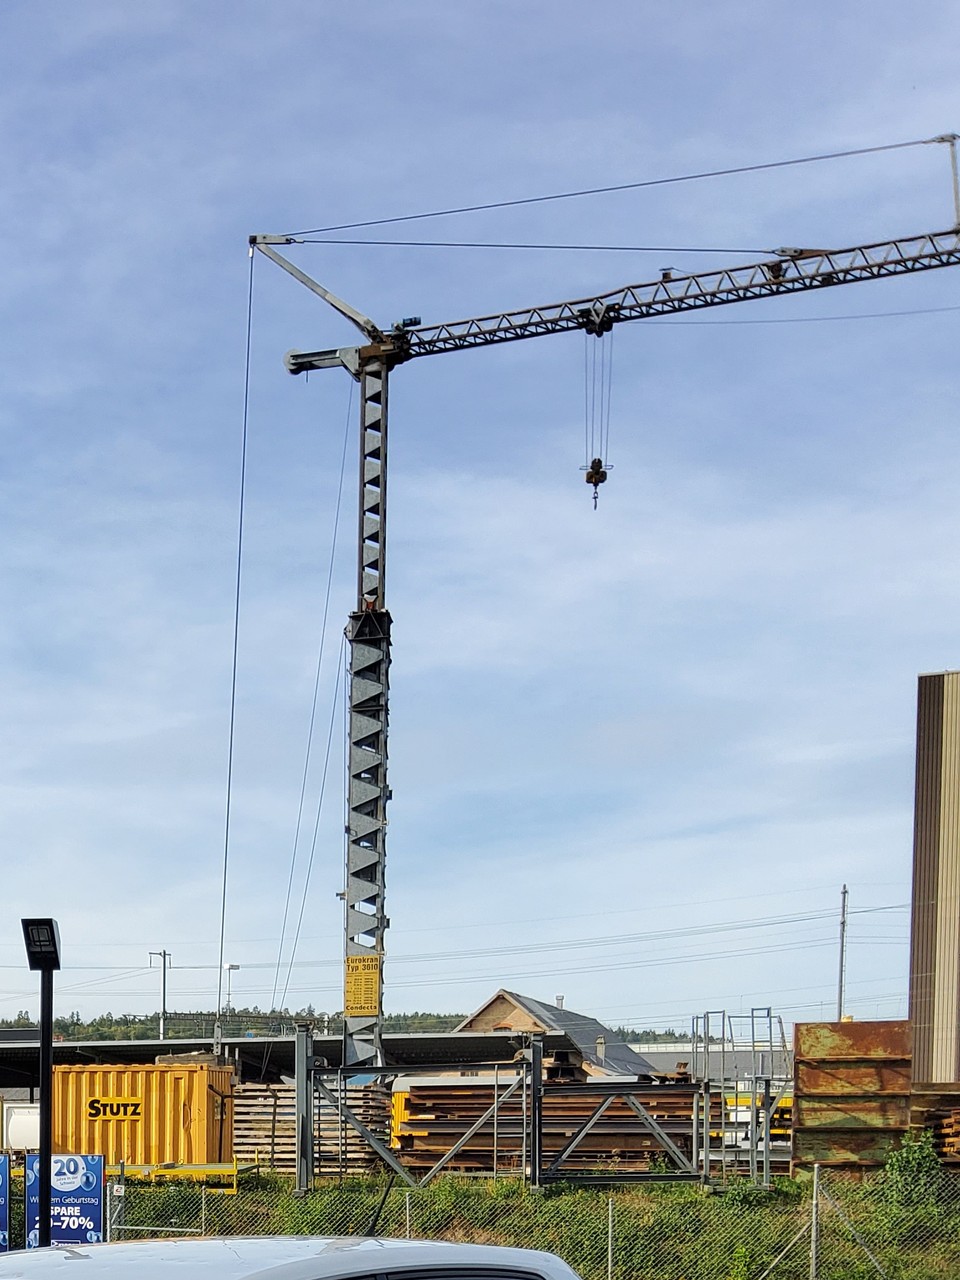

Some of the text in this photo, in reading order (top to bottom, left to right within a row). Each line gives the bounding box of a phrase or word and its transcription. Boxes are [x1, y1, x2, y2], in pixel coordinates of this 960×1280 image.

[53, 1157, 79, 1177] 20
[29, 1196, 39, 1204] Wi
[62, 1196, 99, 1206] Geburtstag
